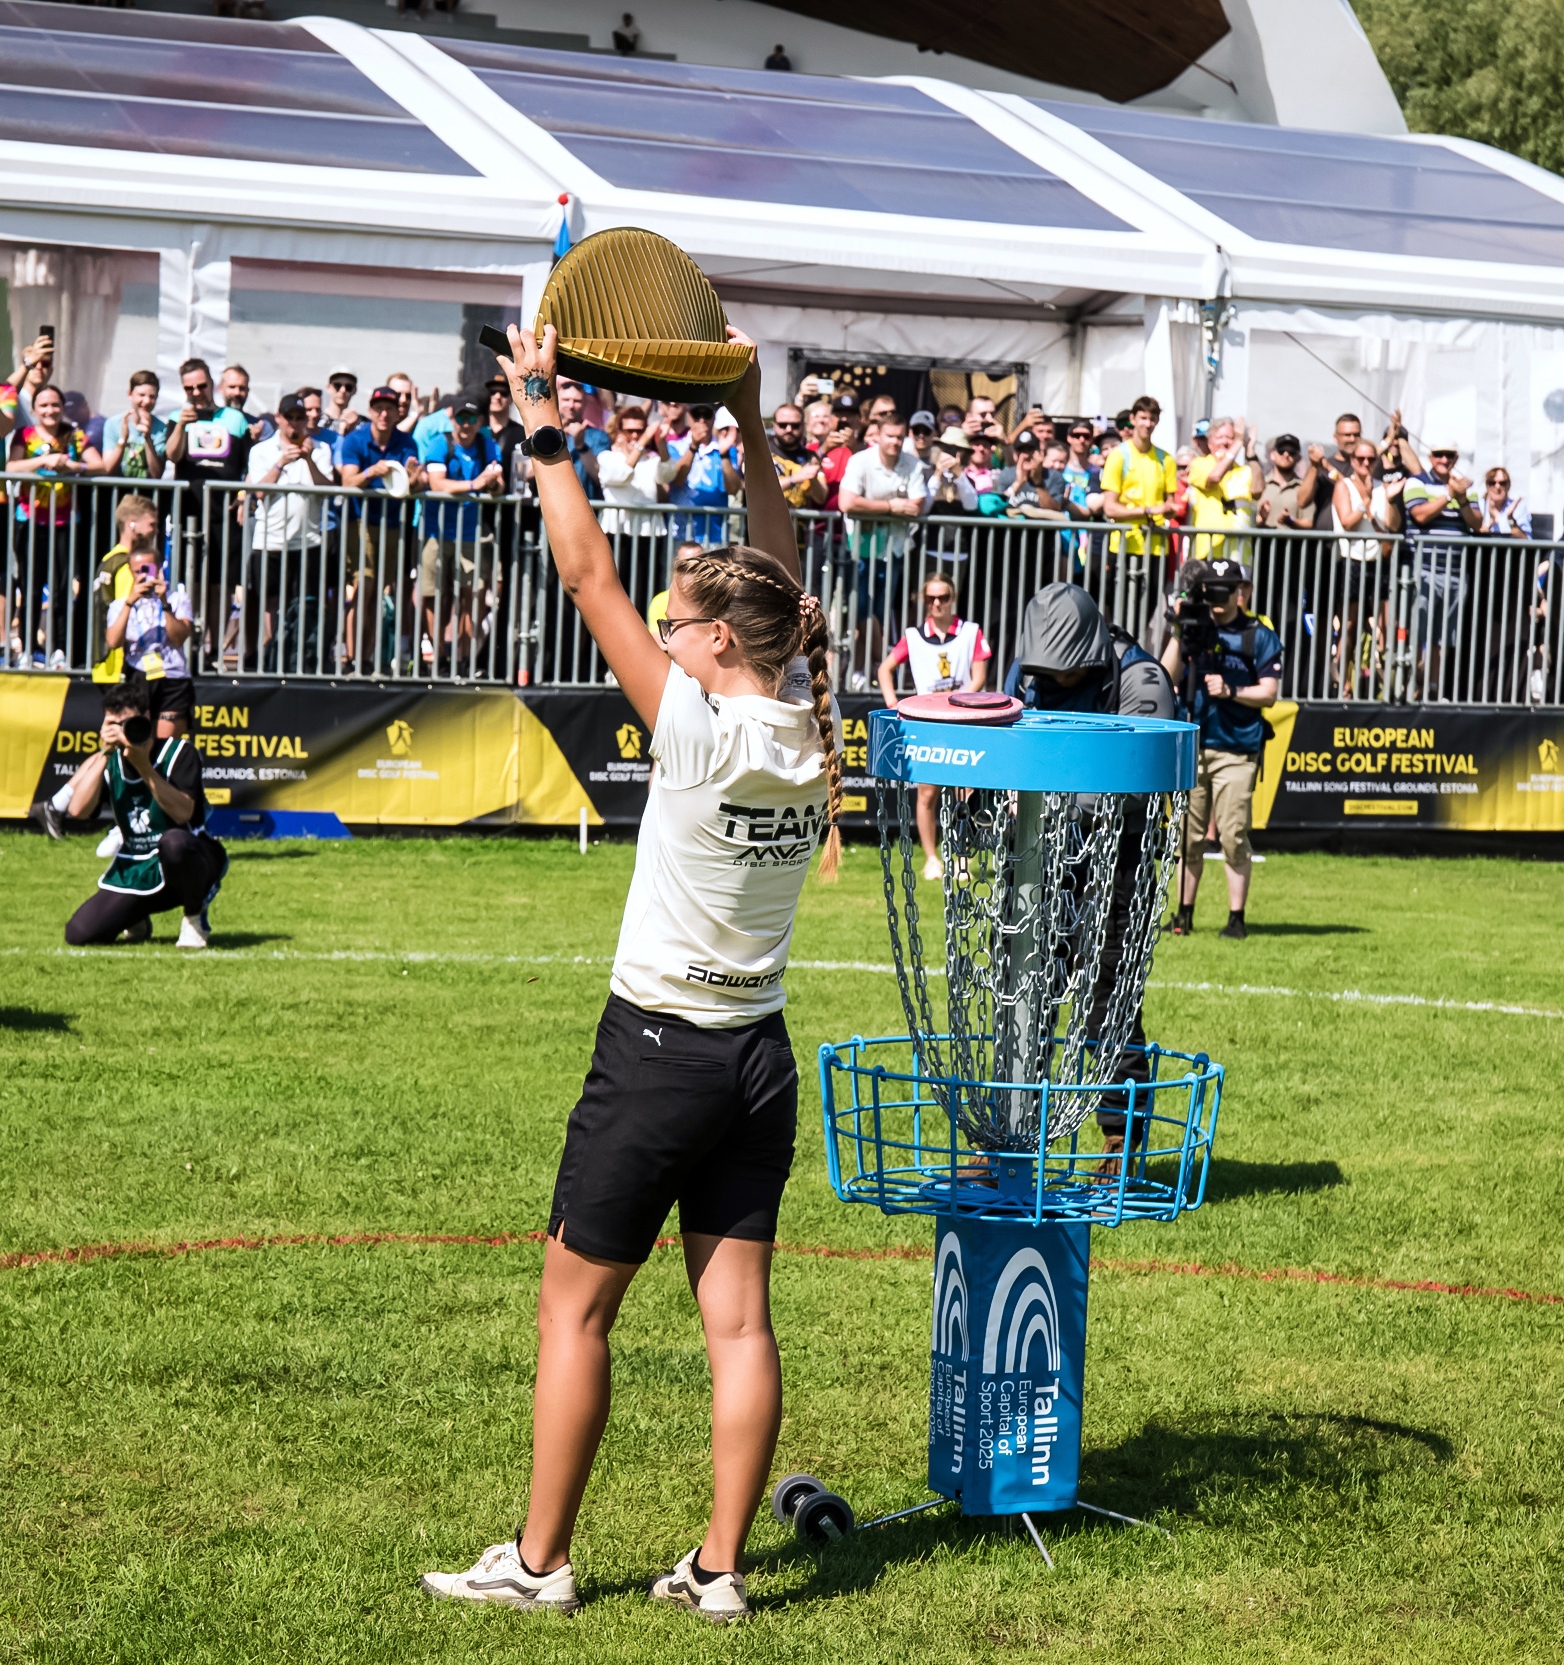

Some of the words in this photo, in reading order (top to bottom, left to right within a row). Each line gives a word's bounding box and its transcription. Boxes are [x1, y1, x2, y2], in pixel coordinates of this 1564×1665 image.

[194, 734, 309, 758] FESTIVAL
[1333, 727, 1435, 749] EUROPEAN
[894, 742, 986, 767] PRODIGY
[1286, 752, 1332, 773] DISC
[1336, 753, 1388, 773] GOLF
[1391, 753, 1479, 775] FESTIVAL
[1285, 780, 1322, 793] TALLINN
[1323, 781, 1349, 793] SONG
[1350, 781, 1392, 793] FESTIVAL
[1440, 782, 1479, 794] ESTONIA
[736, 841, 811, 860] MVP
[732, 859, 767, 868] DISC
[936, 1361, 945, 1415] Capital
[944, 1363, 953, 1437] European
[978, 1381, 997, 1426] Sport
[997, 1380, 1015, 1435] Capital
[936, 1418, 945, 1436] of
[950, 1369, 968, 1474] Tallinn
[1014, 1379, 1032, 1454] European
[1031, 1377, 1060, 1486] Tallinn
[978, 1428, 994, 1470] 2025
[997, 1439, 1014, 1457] of
